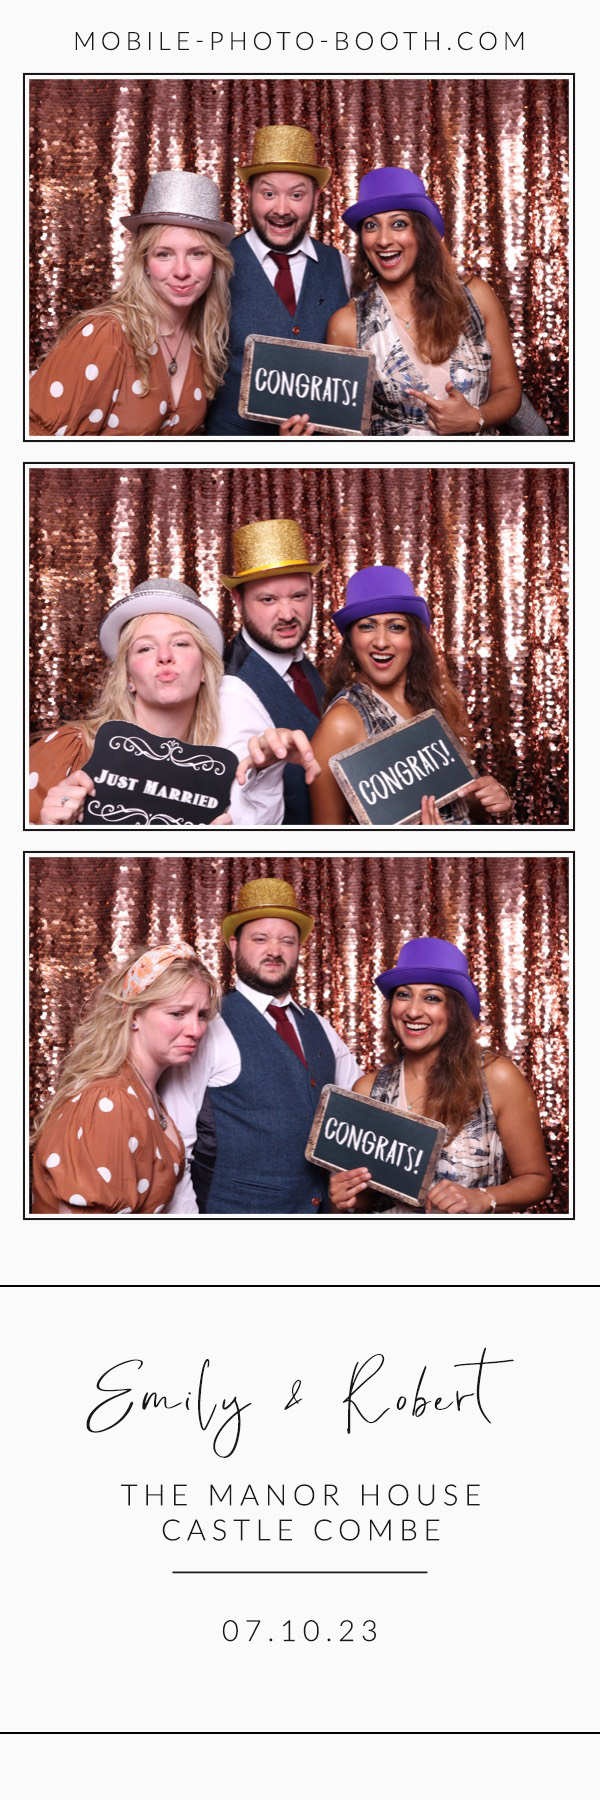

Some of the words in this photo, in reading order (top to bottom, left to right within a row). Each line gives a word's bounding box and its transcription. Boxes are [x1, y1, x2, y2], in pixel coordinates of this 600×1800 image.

[255, 367, 359, 407] CONGRATS!
[358, 739, 456, 806] CONGRATS!
[324, 1116, 424, 1175] CONGRATS!
